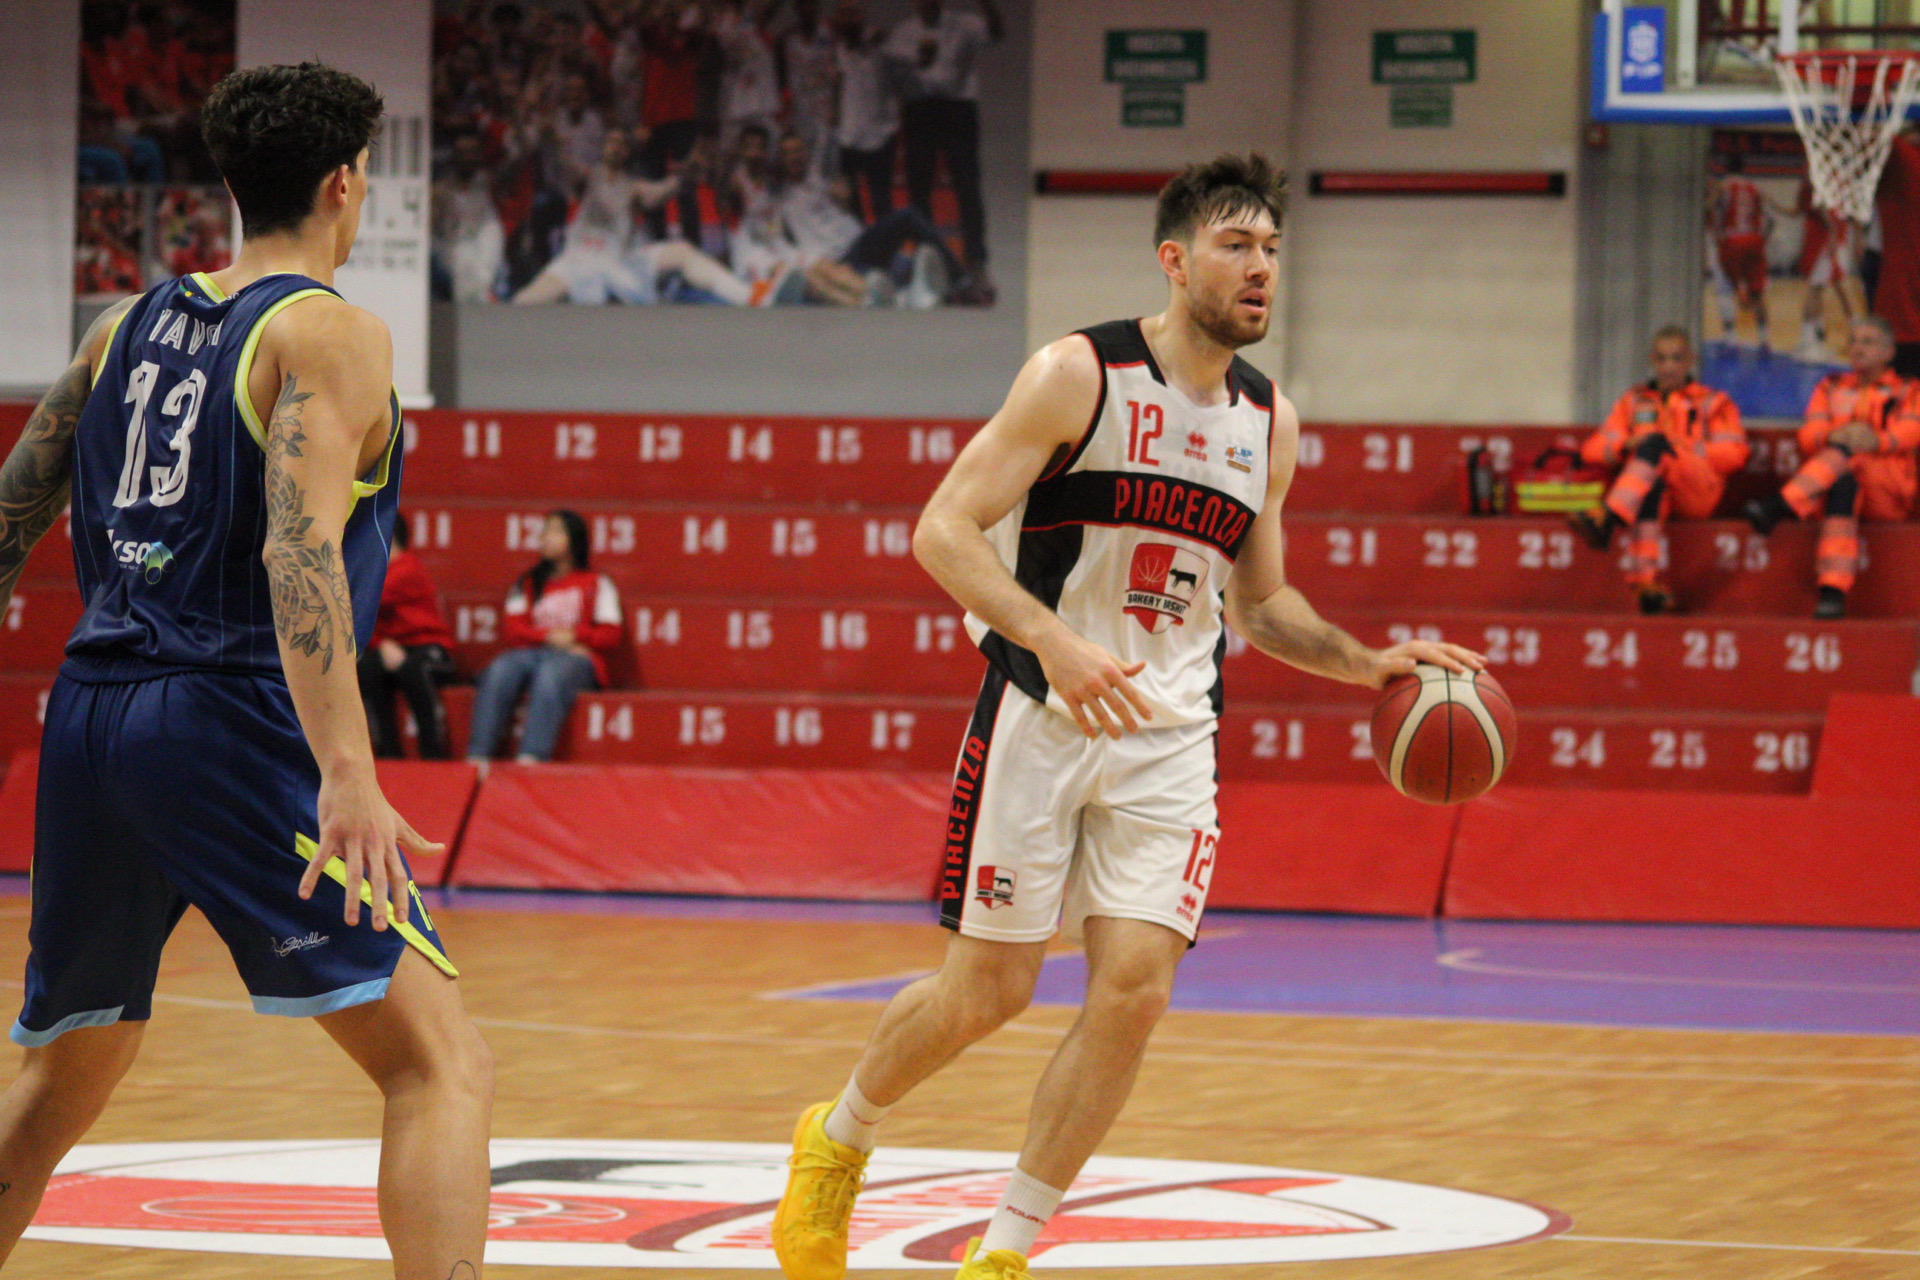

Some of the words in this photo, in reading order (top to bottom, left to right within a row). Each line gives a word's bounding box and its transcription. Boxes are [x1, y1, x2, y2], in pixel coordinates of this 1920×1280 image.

[112, 360, 207, 508] 13
[463, 421, 501, 457] 11
[555, 423, 597, 459] 12
[639, 425, 682, 462] 13
[729, 425, 773, 461] 14
[817, 426, 861, 463] 15
[909, 428, 954, 464] 16
[1127, 400, 1163, 467] 12
[1364, 434, 1413, 472] 21
[413, 512, 451, 548] 11
[1114, 478, 1249, 548] PIACENZA
[506, 514, 546, 550] 12
[593, 517, 635, 553] 13
[683, 517, 727, 554] 14
[772, 519, 817, 556] 15
[865, 520, 910, 556] 16
[1327, 528, 1377, 565] 21
[1424, 531, 1478, 567] 22
[1519, 531, 1573, 568] 23
[456, 606, 497, 643] 12
[636, 608, 680, 644] 14
[727, 611, 772, 648] 15
[821, 612, 868, 650] 16
[915, 615, 957, 652] 17
[1484, 627, 1540, 667] 23
[1585, 630, 1638, 668] 24
[1683, 630, 1739, 669] 25
[1786, 634, 1841, 672] 26
[588, 703, 633, 741] 14
[679, 706, 726, 744] 15
[775, 708, 822, 745] 16
[871, 711, 915, 749] 17
[1252, 720, 1304, 759] 21
[1551, 729, 1605, 767] 24
[1650, 730, 1707, 768] 25
[1754, 733, 1809, 772] 26
[943, 736, 986, 899] PIACENZA
[1183, 828, 1217, 892] 12
